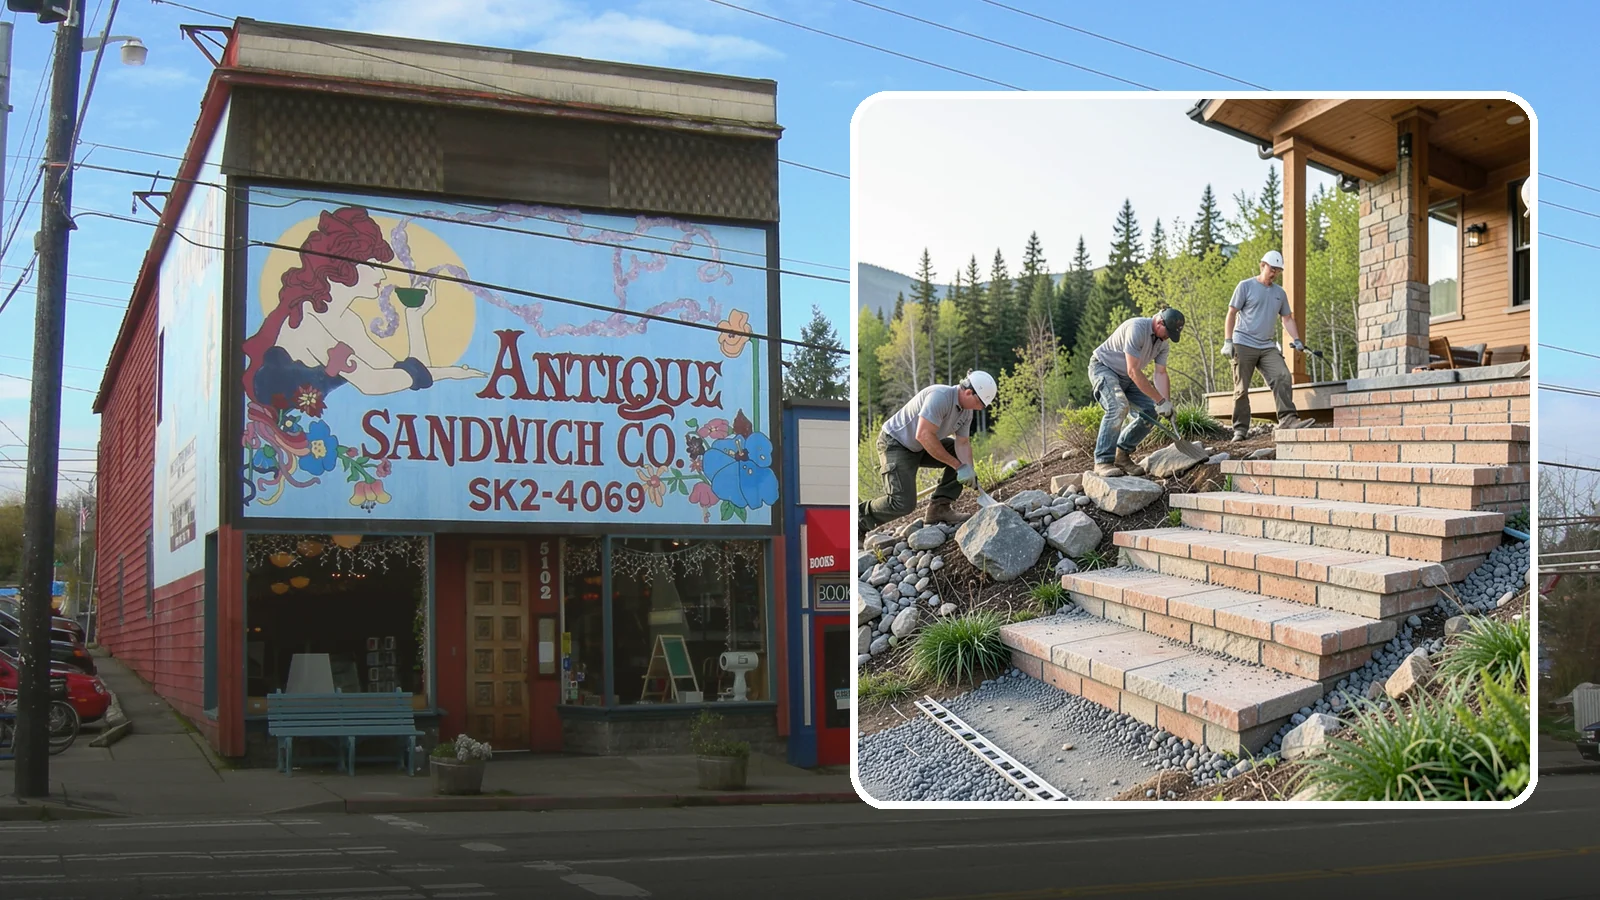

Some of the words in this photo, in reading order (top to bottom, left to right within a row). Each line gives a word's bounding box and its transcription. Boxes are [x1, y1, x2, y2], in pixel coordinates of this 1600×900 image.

[476, 329, 722, 420] ANTIQUE
[361, 408, 605, 467] SANDWICH
[616, 419, 686, 470] CO.
[468, 476, 646, 514] SK2-4069
[540, 542, 551, 599] 5102
[809, 555, 834, 568] BOOKS
